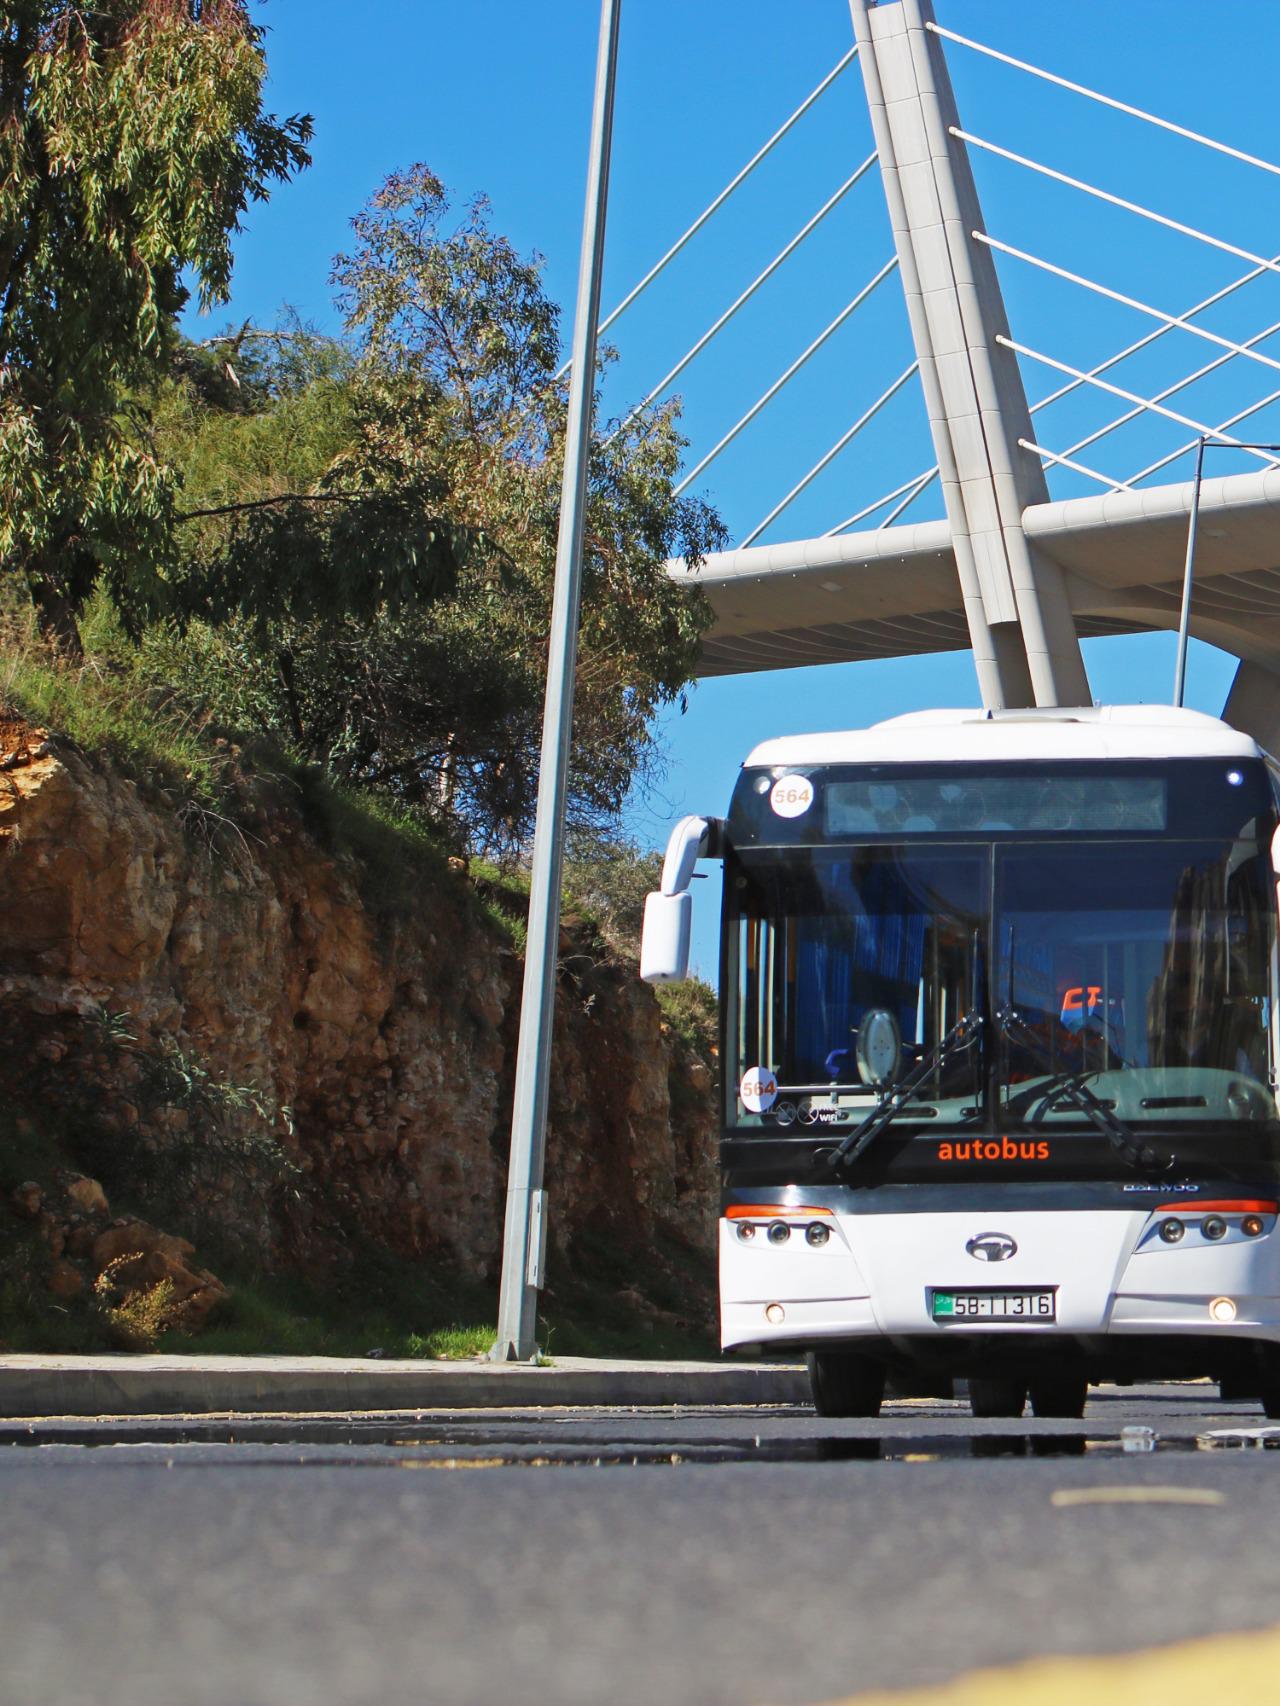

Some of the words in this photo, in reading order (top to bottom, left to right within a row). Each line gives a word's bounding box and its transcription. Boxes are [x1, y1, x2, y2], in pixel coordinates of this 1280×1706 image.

[775, 789, 809, 803] 564
[743, 1081, 775, 1096] 564
[938, 1136, 1049, 1160] autobus
